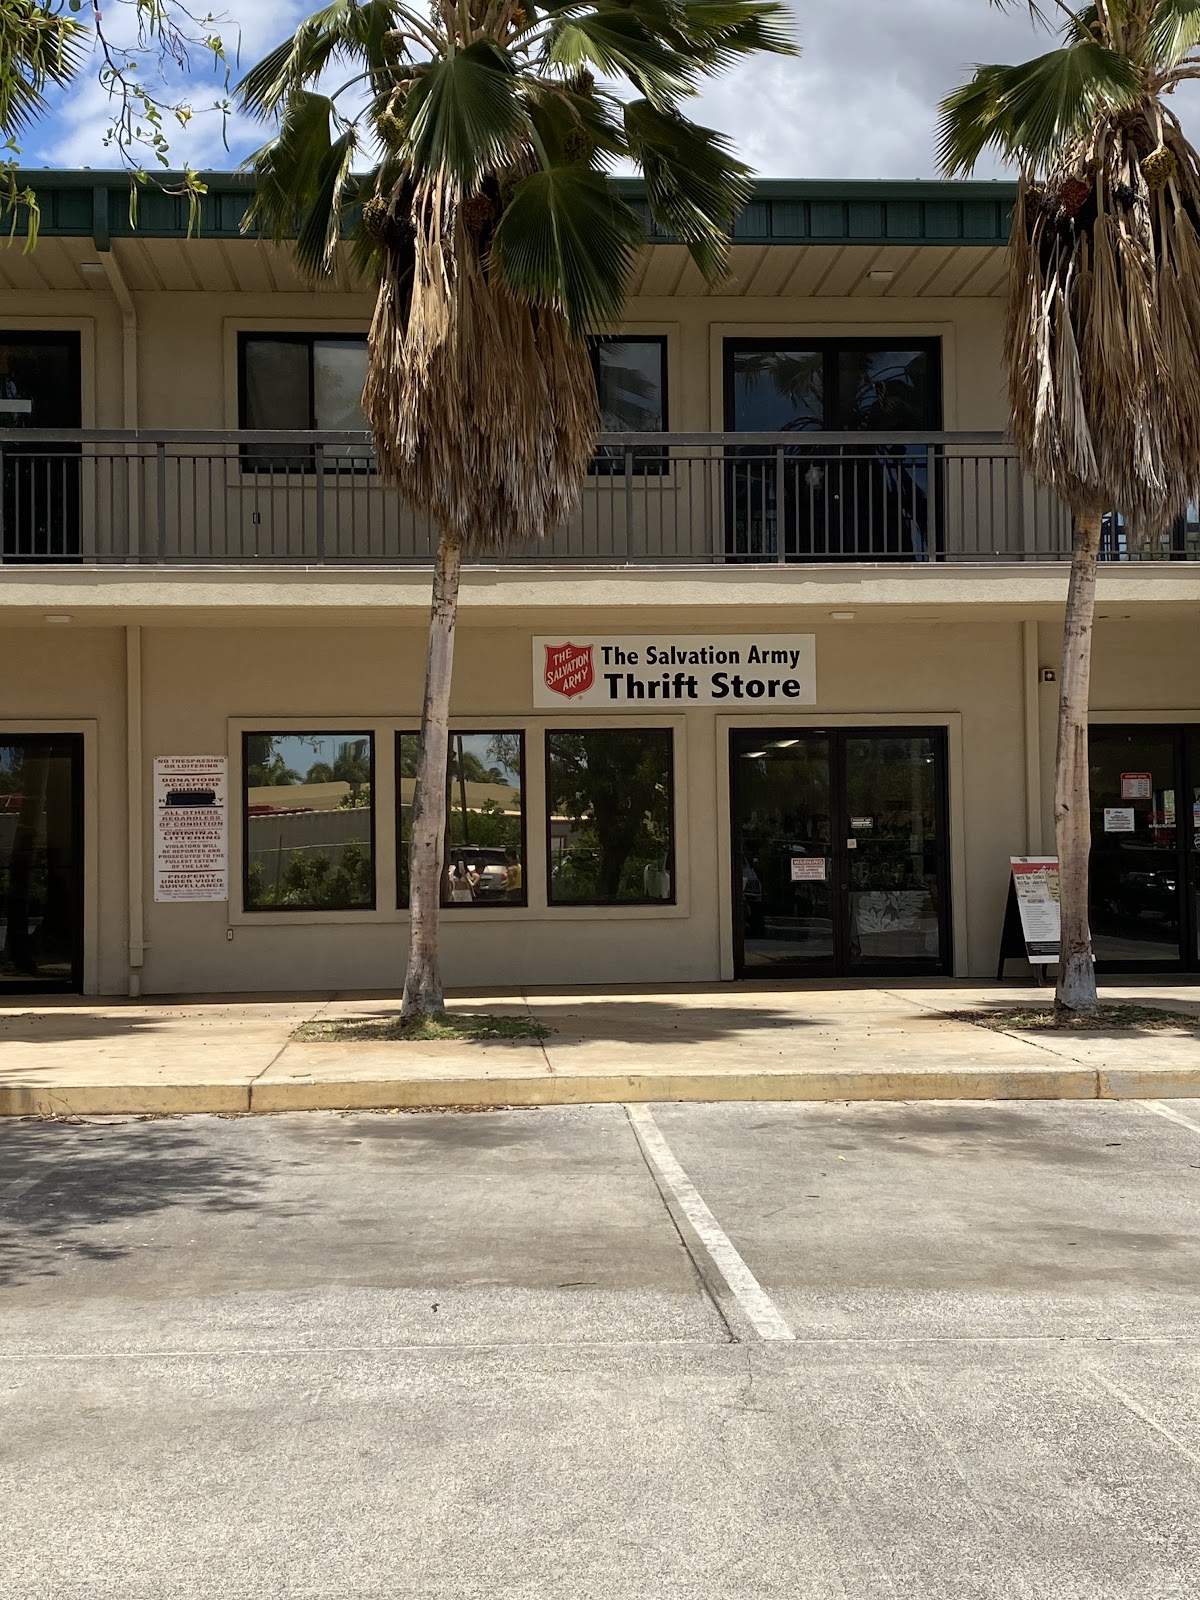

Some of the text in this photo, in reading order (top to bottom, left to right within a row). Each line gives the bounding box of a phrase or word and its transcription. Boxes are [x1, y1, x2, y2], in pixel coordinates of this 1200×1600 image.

[547, 650, 589, 685] SALVATION
[553, 648, 572, 666] THE
[601, 645, 800, 669] The Salvation Army
[563, 667, 588, 691] ARMY
[604, 672, 800, 699] Thrift Store
